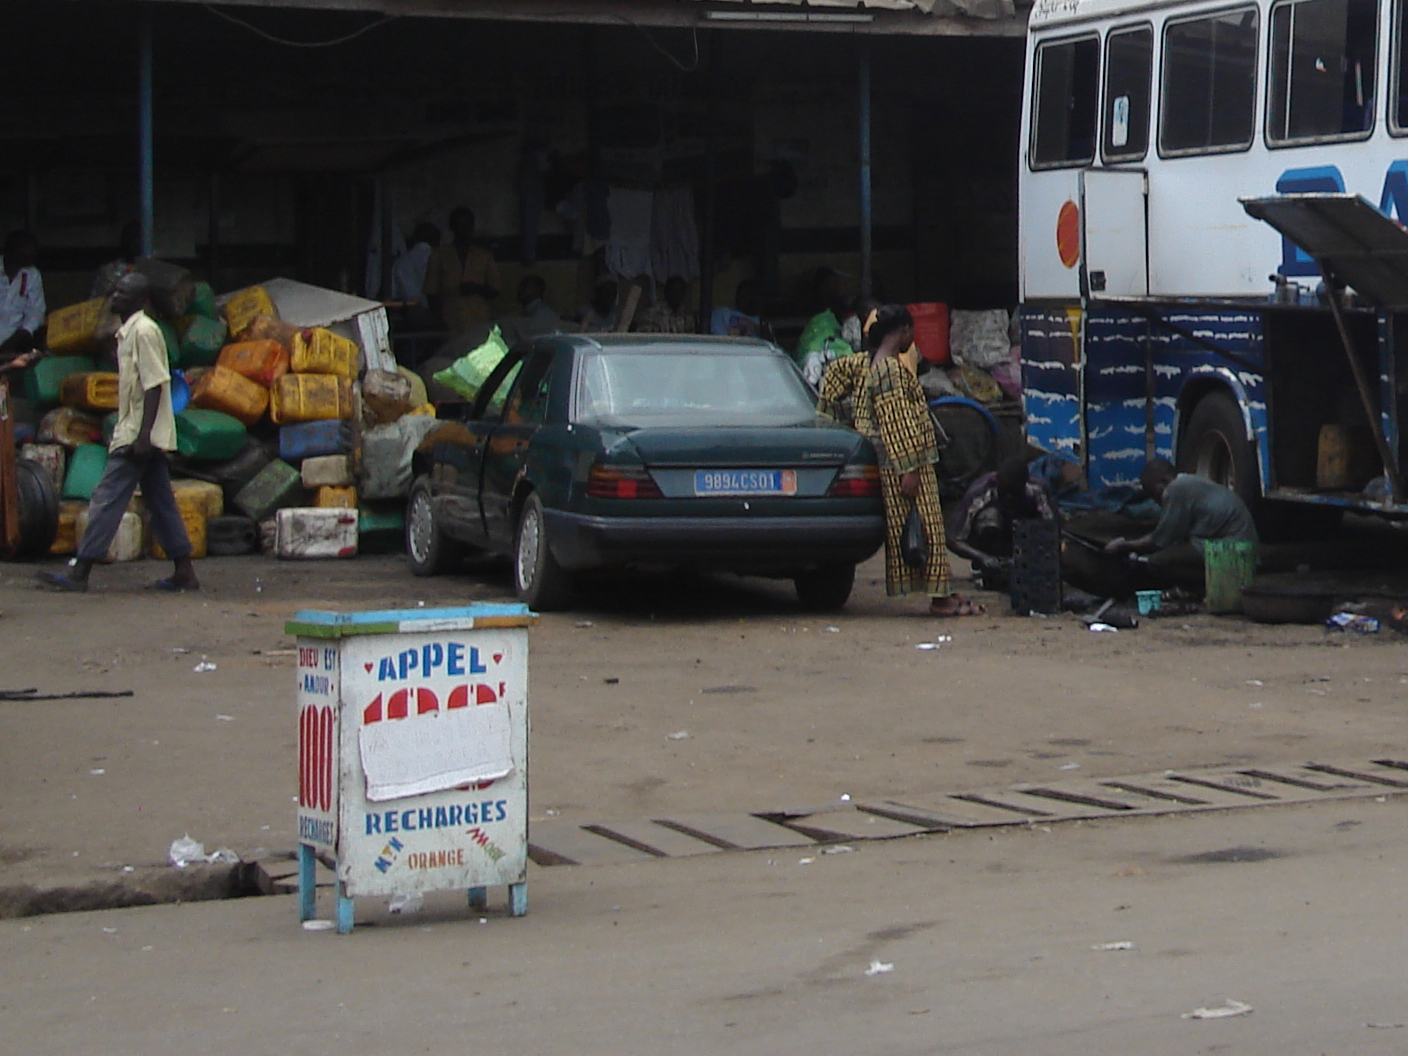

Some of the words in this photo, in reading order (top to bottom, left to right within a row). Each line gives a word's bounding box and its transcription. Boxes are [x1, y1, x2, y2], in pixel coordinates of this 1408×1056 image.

[705, 473, 774, 489] 9894CS01
[300, 648, 319, 667] DIEU
[324, 648, 336, 671] EST
[378, 642, 487, 681] APPEL
[365, 800, 507, 835] RECHARGES
[408, 848, 464, 870] ORANGE
